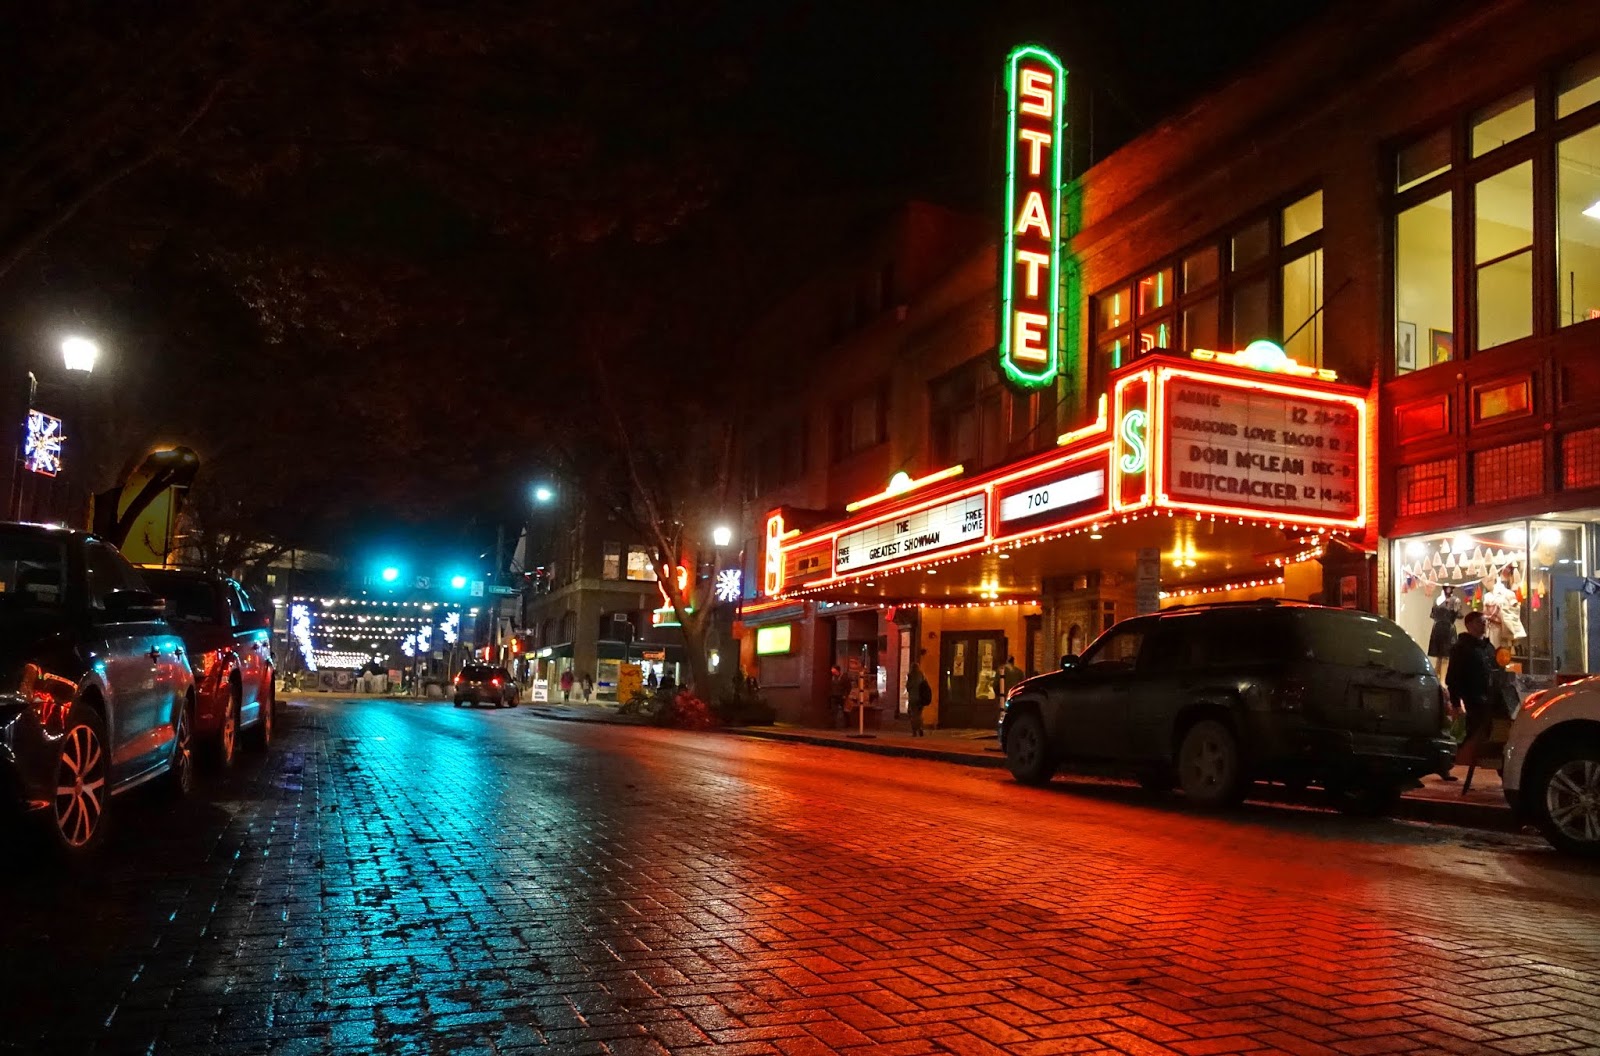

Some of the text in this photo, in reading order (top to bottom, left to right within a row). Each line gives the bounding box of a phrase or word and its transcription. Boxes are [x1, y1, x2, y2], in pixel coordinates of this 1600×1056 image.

[1013, 68, 1053, 363] STATE
[1178, 390, 1221, 407] ANNIE
[1292, 406, 1308, 425] 12
[1120, 409, 1147, 474] S
[1172, 415, 1238, 437] DRAGONS
[1243, 425, 1277, 443] LOVE
[1282, 430, 1324, 449] TACOS
[1189, 444, 1229, 466] DON
[1179, 470, 1298, 500] NUTCRACKER
[1303, 485, 1316, 500] 12
[896, 519, 910, 535] THE
[962, 519, 983, 534] MOVIE
[965, 508, 983, 522] FREE
[838, 546, 850, 556] FREE
[869, 531, 941, 560] GREATEST SHOWMAN
